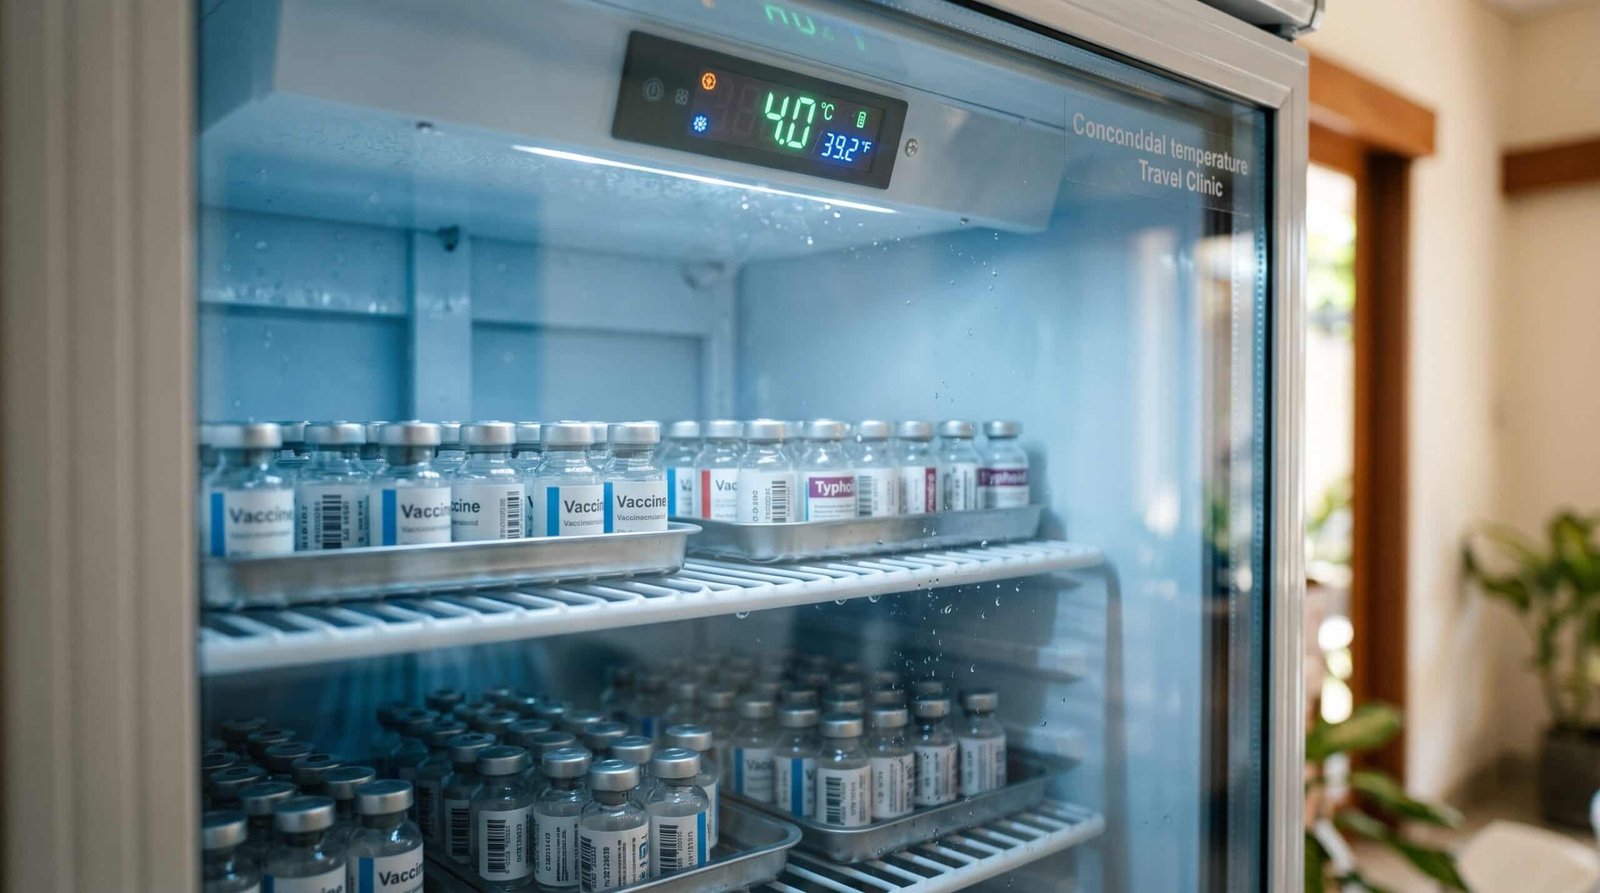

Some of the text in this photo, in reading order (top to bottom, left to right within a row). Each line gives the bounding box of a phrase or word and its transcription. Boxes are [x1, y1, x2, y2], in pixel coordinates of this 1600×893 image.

[764, 91, 816, 149] 4.0
[821, 132, 859, 162] 39.2
[1170, 137, 1249, 176] temperature
[1138, 158, 1224, 197] Travel Clinic
[617, 494, 667, 508] Vaccine
